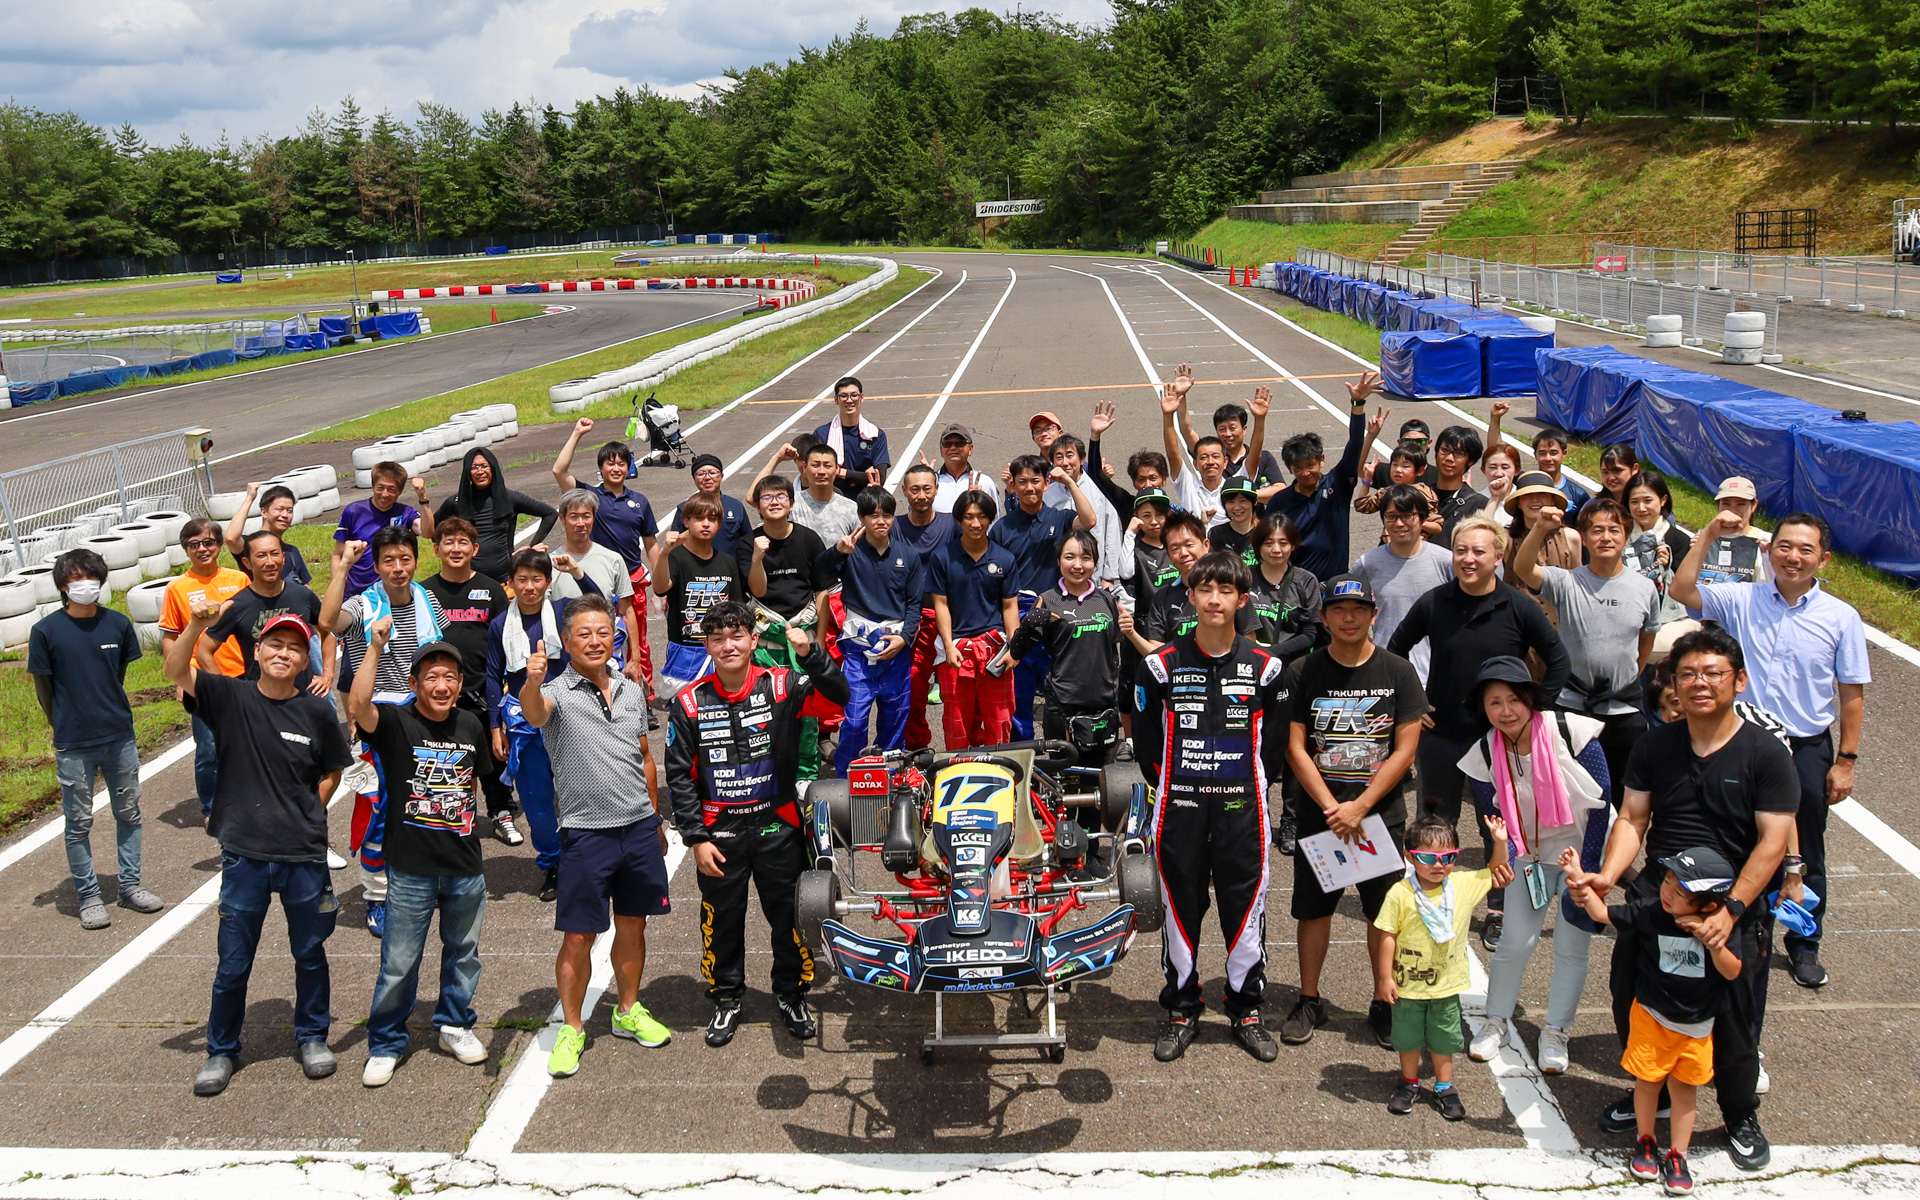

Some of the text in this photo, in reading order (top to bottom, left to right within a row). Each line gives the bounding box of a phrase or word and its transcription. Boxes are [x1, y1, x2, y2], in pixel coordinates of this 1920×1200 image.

[1237, 663, 1253, 674] K6
[1173, 675, 1207, 684] IKEDO
[750, 693, 766, 704] K6
[1327, 689, 1368, 697] TAKUMA
[698, 710, 730, 720] IKEDO
[1311, 697, 1381, 732] TK
[1182, 738, 1206, 750] KDDI
[1181, 750, 1244, 761] Neuro Racer
[413, 746, 468, 783] TK
[1181, 759, 1221, 771] Project
[713, 768, 736, 778] KDDI
[745, 773, 773, 786] Racer
[852, 781, 883, 789] ROTAX
[716, 787, 753, 798] Project
[937, 774, 1012, 810] 17
[951, 833, 991, 844] ACCEL
[957, 909, 981, 920] K6
[946, 948, 1007, 963] IKEDO
